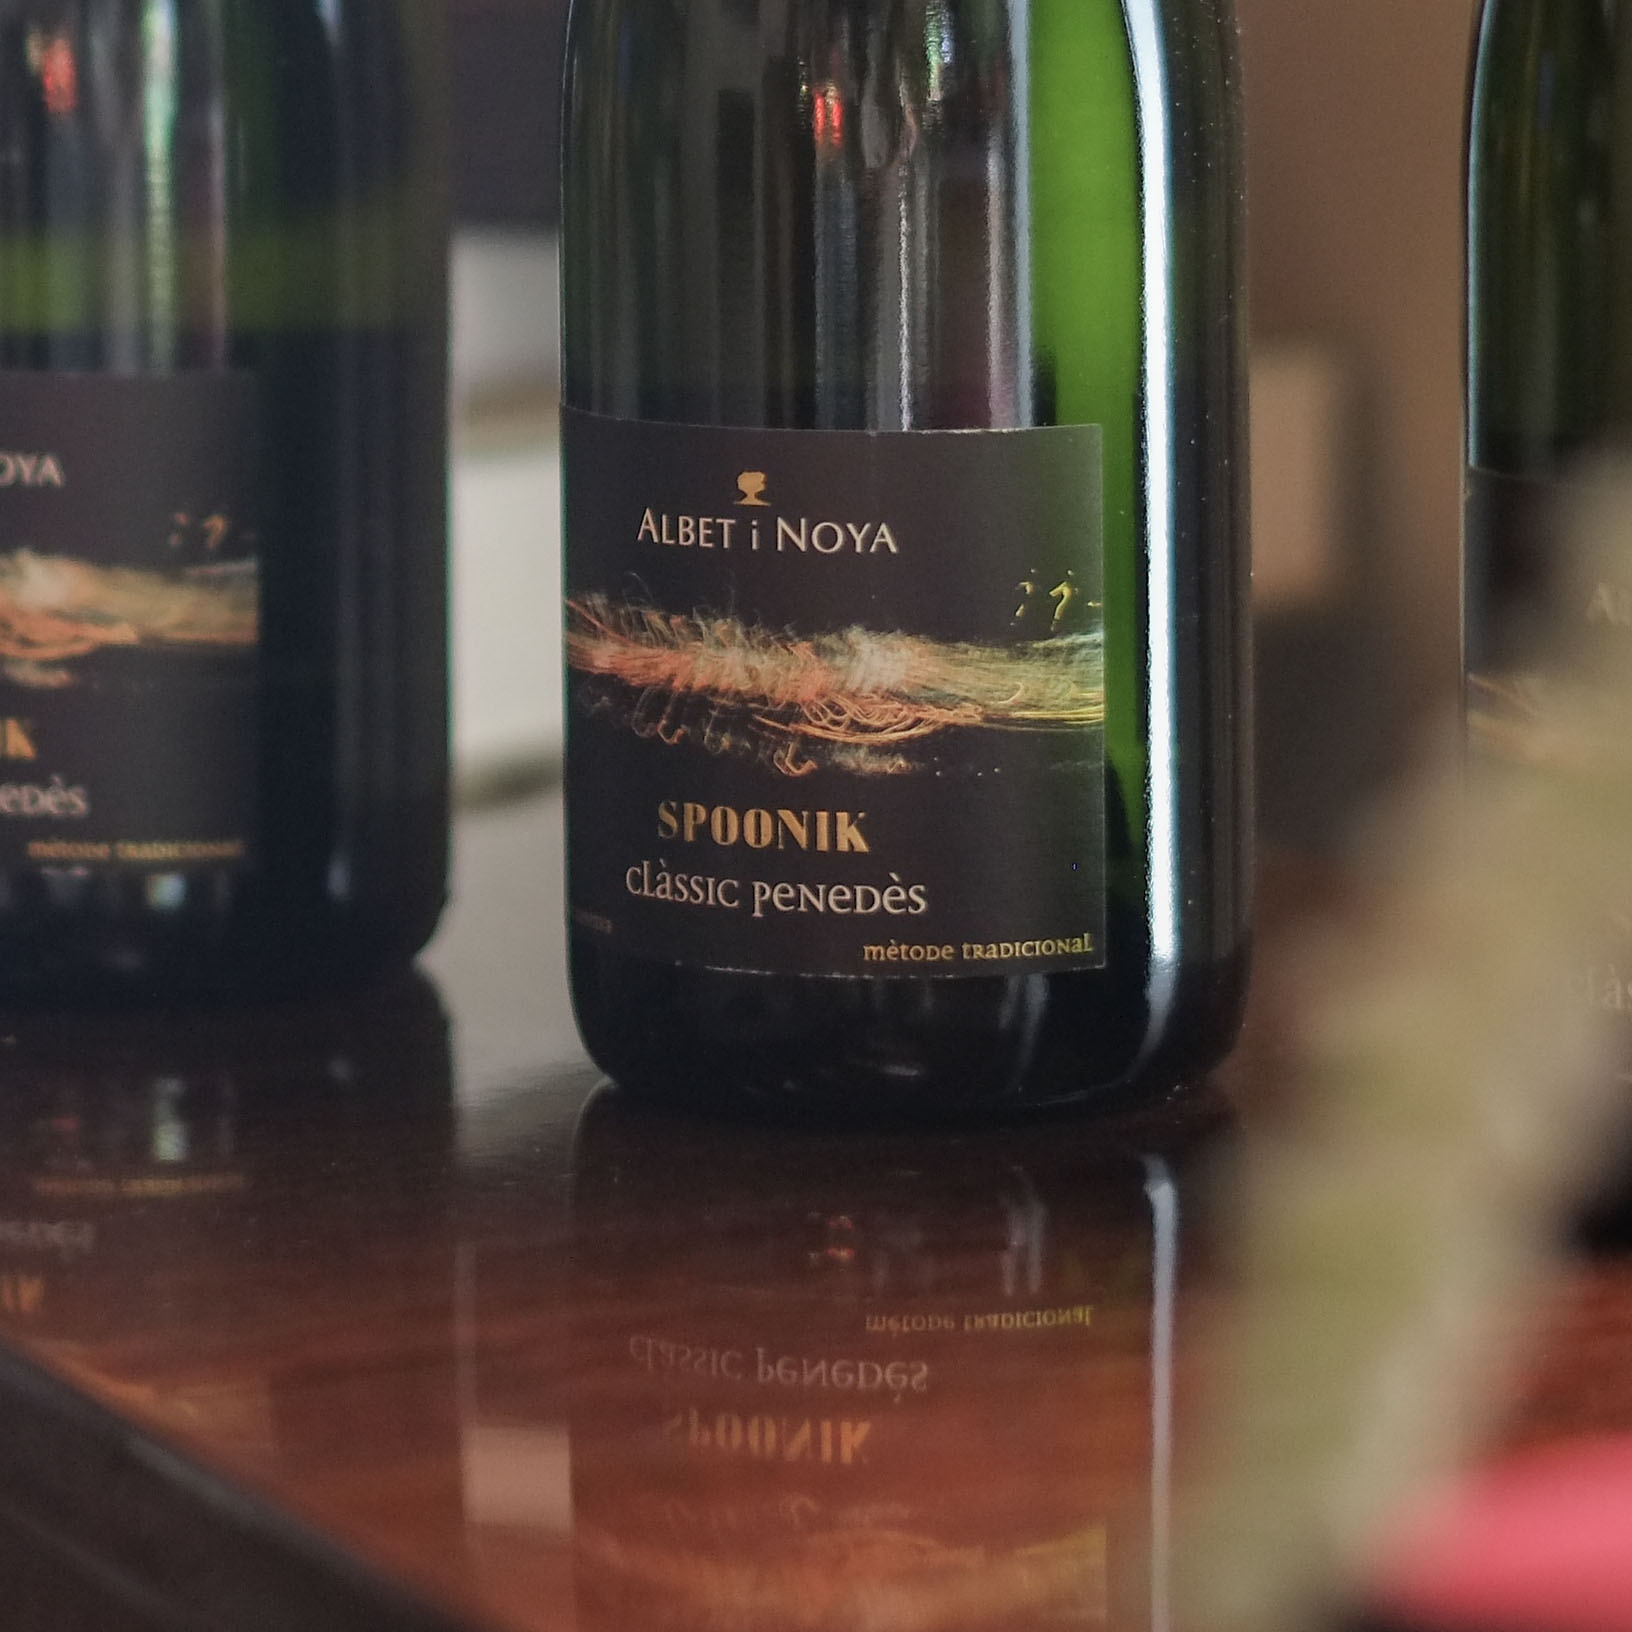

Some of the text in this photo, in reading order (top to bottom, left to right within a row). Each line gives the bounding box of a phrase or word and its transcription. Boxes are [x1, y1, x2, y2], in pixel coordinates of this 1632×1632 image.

[637, 507, 736, 549] ALBET
[776, 516, 899, 554] NOYA
[657, 800, 870, 853] SPOONIK
